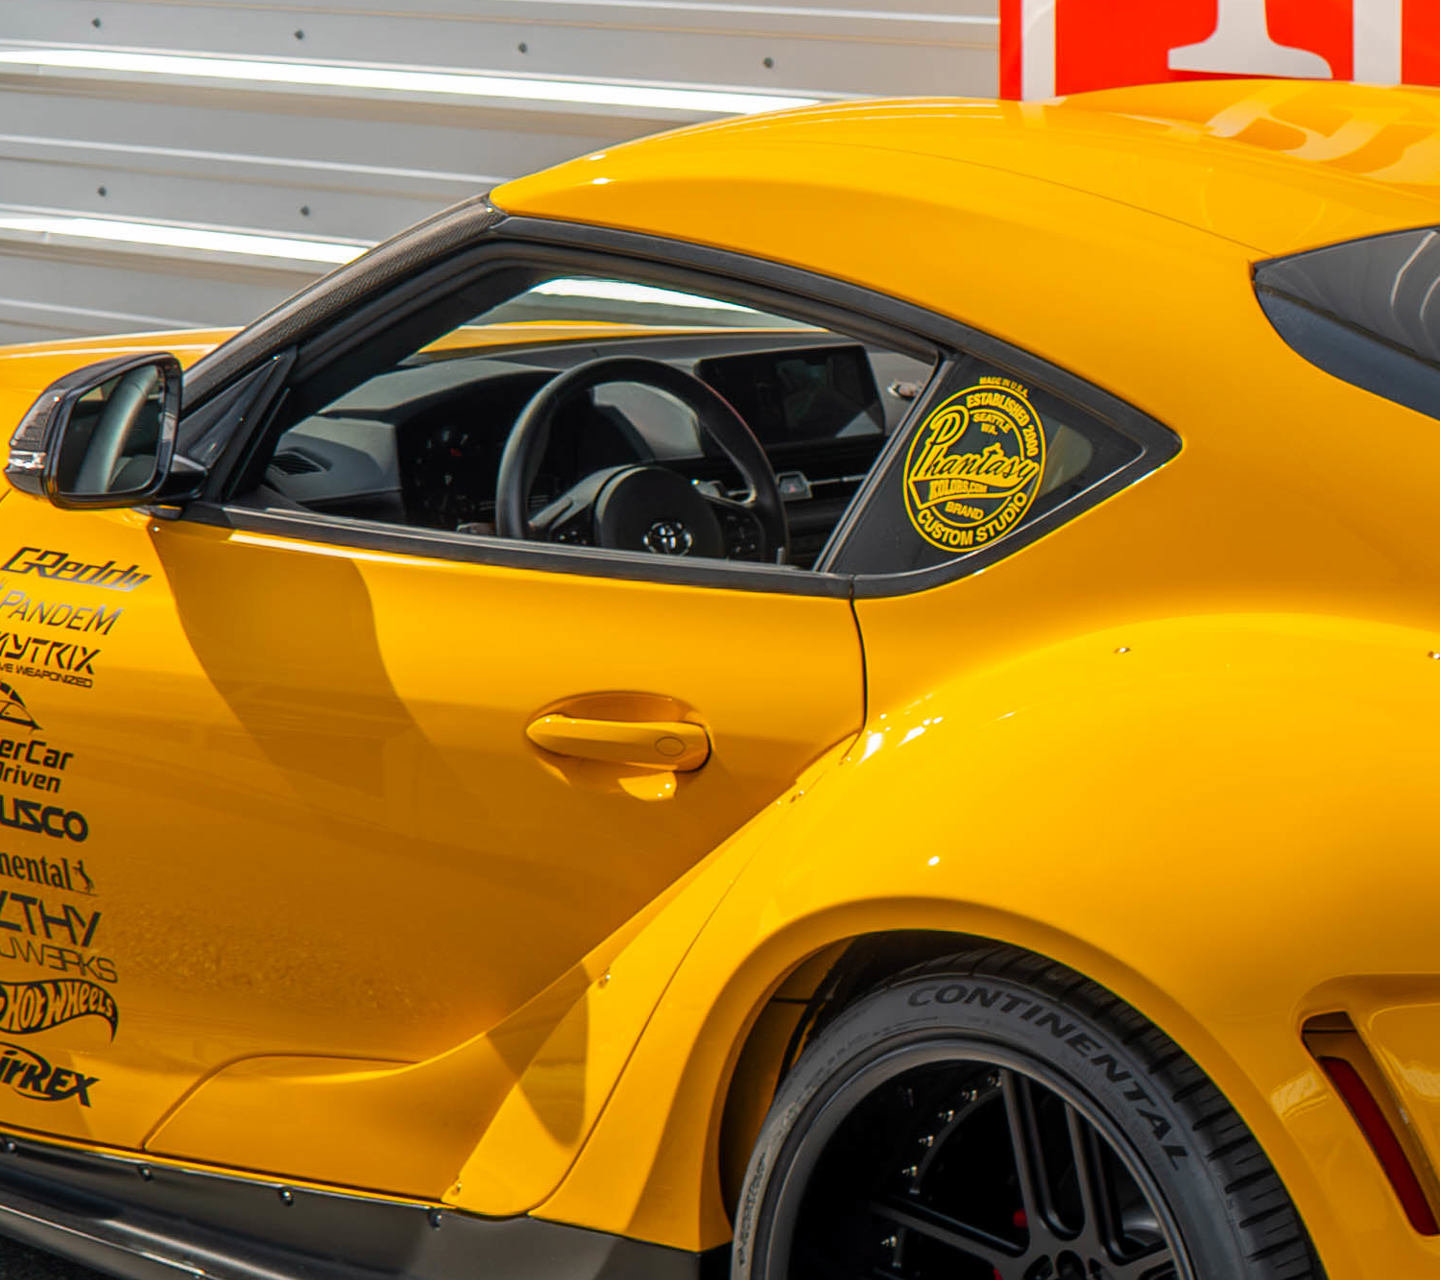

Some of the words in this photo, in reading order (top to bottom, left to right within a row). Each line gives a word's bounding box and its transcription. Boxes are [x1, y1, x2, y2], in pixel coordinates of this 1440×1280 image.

[910, 405, 1040, 486] Phantasy
[966, 392, 1030, 427] ESTABLISHED
[1022, 424, 1039, 457] 2000
[973, 413, 1012, 434] SEATTLE
[918, 508, 974, 546] CUSTOM
[975, 492, 1028, 542] STUDIO
[944, 501, 985, 520] BRAND
[15, 664, 93, 689] WEAPONIZED
[907, 984, 1188, 1170] CONTINENTAL
